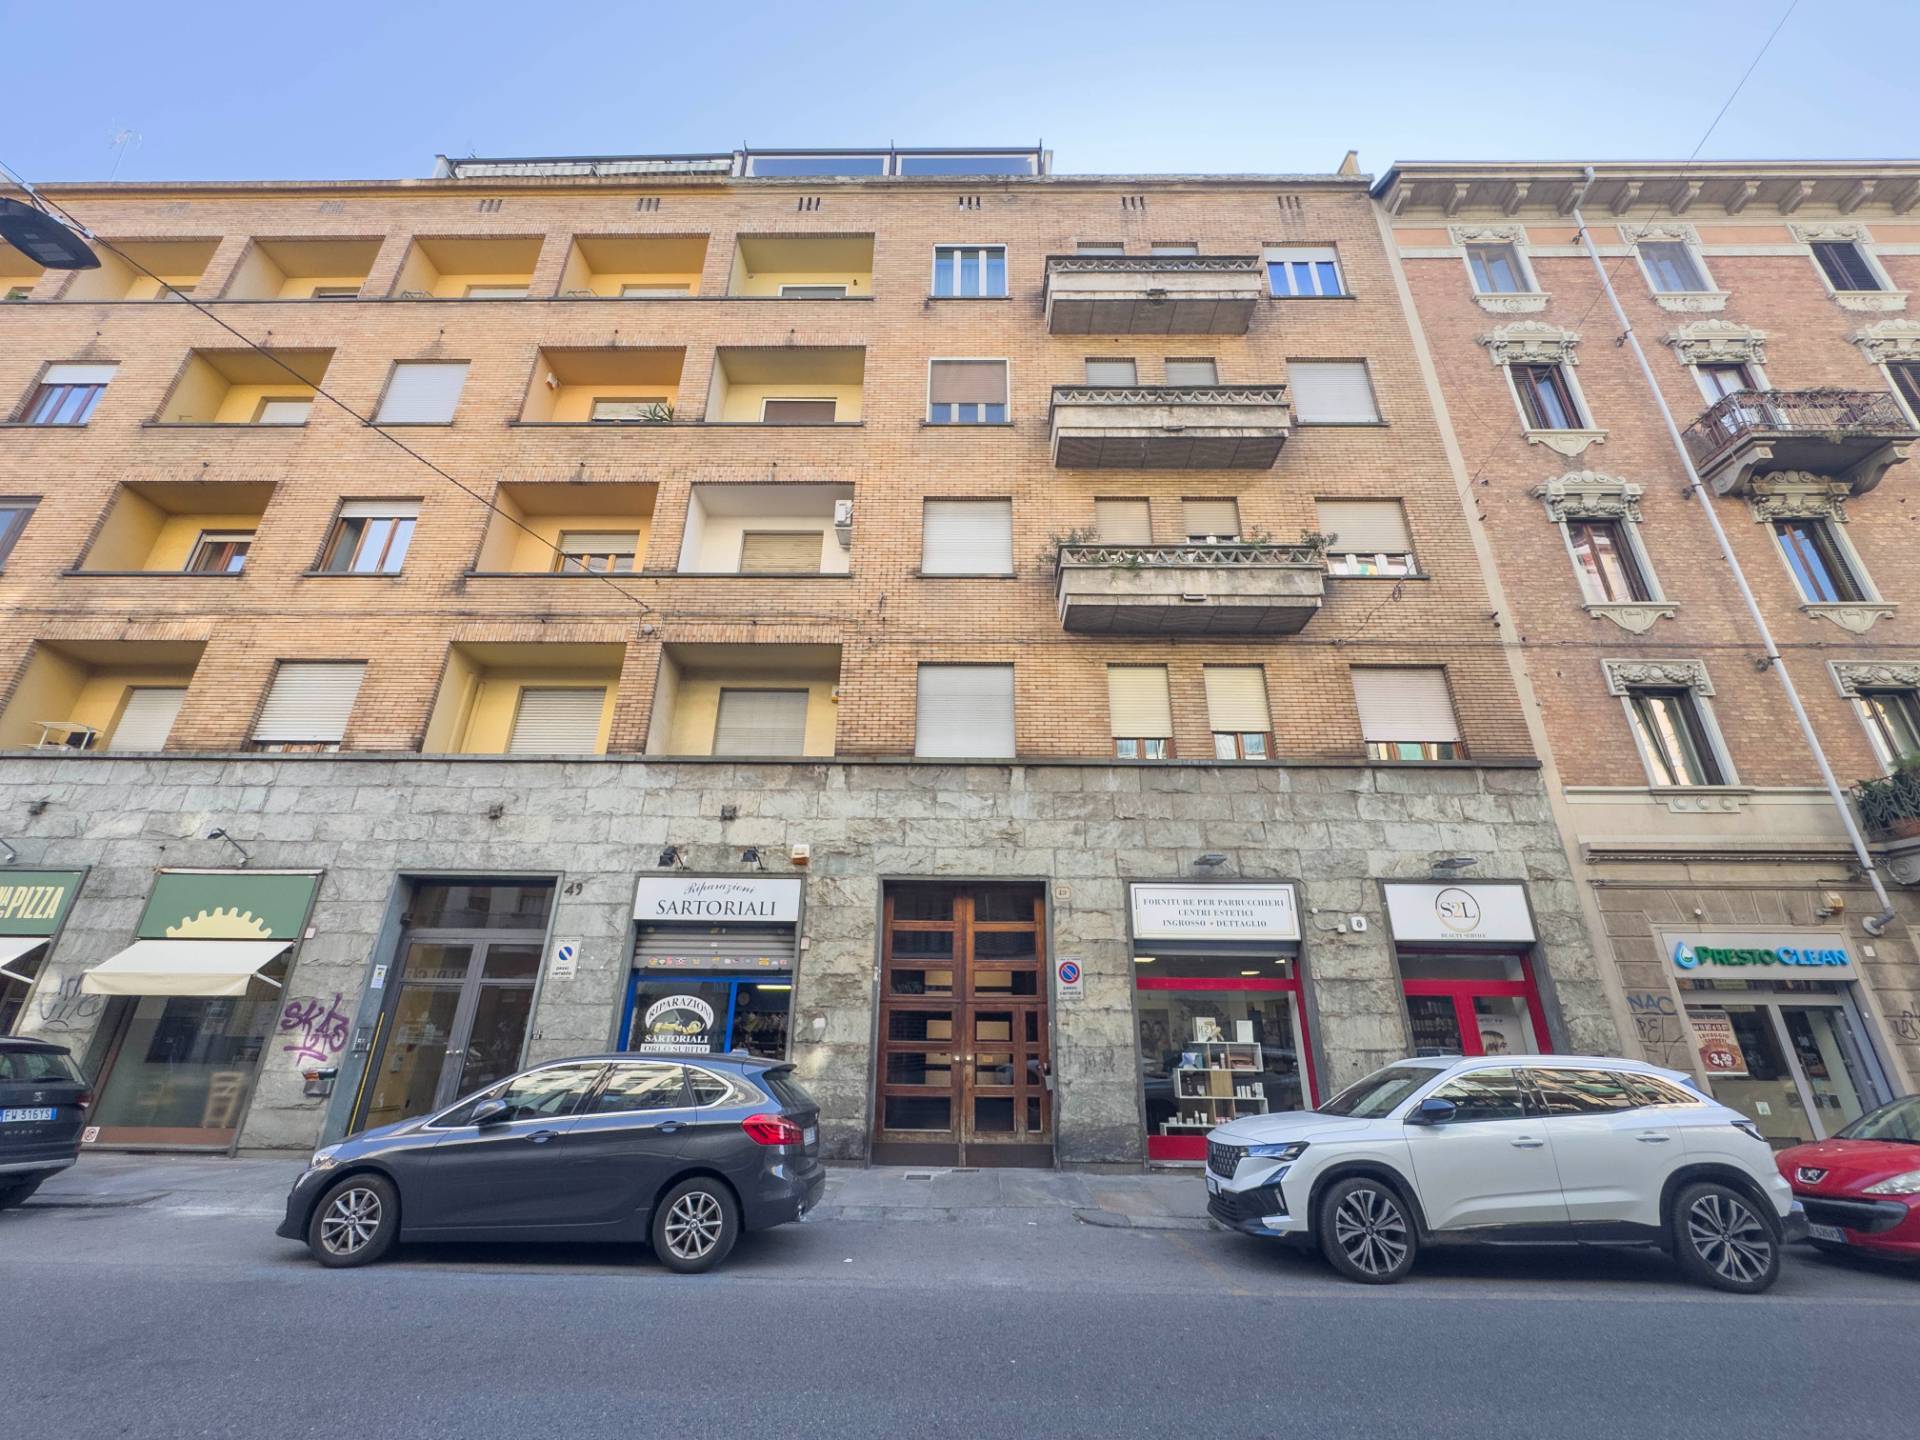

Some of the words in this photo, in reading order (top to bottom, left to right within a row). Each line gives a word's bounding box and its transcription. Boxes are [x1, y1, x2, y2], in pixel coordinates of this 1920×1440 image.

[564, 882, 583, 896] 49
[684, 881, 755, 897] Riparazioni
[4, 886, 65, 919] PIZZA
[655, 899, 776, 916] SARTORIALI
[1143, 898, 1194, 906] FORNITURE
[1197, 898, 1215, 906] PER
[1217, 899, 1285, 907] PARRUCCHIERI
[1162, 919, 1206, 927] INGROSSO
[1216, 920, 1267, 928] DETTAGLIO
[649, 997, 712, 1020] RIPARAZIONI
[644, 1033, 709, 1043] SARTORIALI
